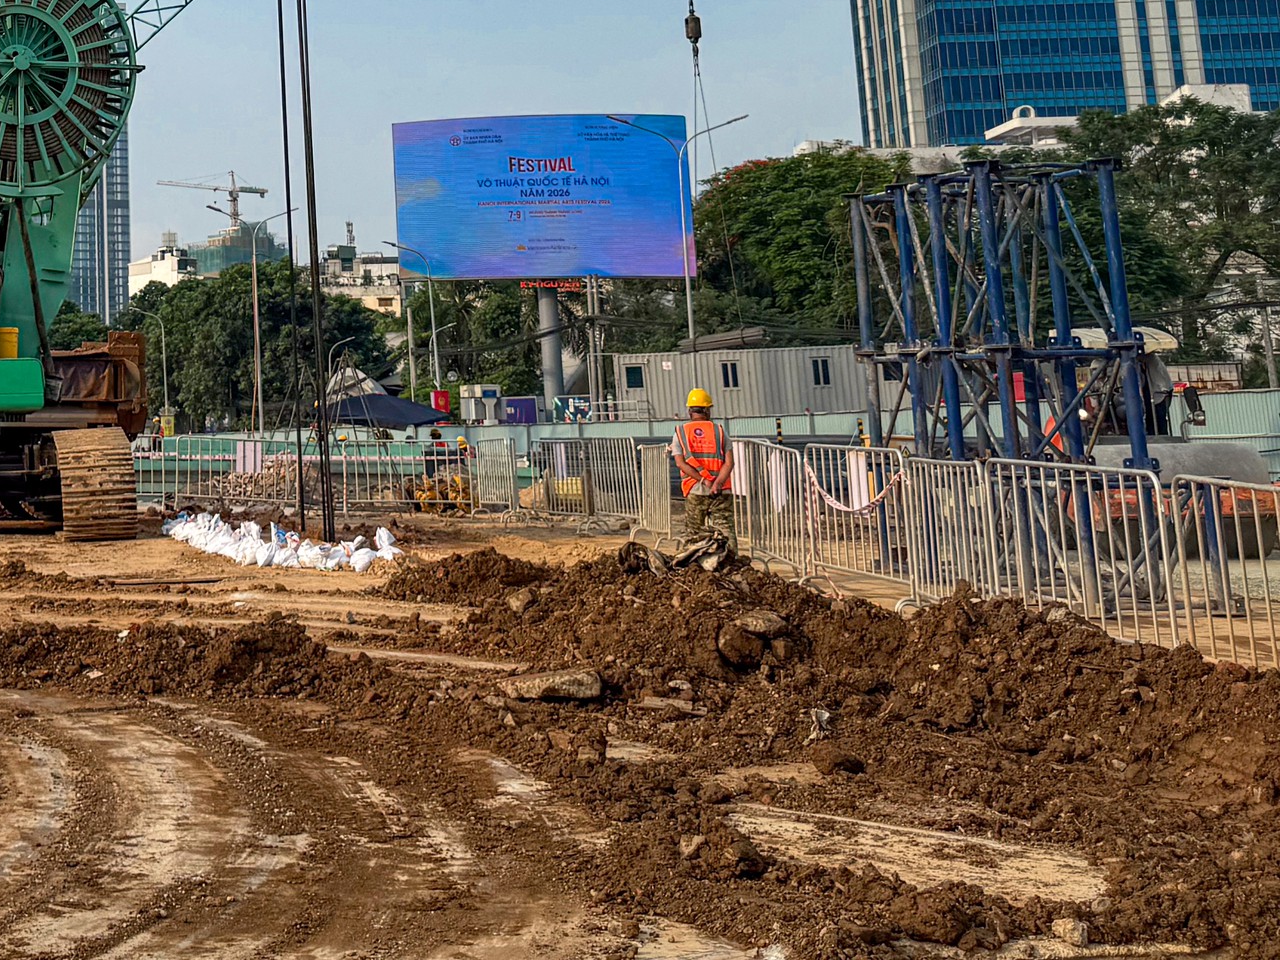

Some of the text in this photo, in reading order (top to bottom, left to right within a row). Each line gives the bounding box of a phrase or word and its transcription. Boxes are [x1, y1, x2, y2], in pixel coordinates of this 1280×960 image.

[508, 156, 576, 173] FESTIVAL
[477, 174, 609, 189] VÕ THUẬT QUỐC TẾ HÀ NỘI
[520, 188, 571, 198] NĂM 2026
[508, 210, 522, 219] 7-9
